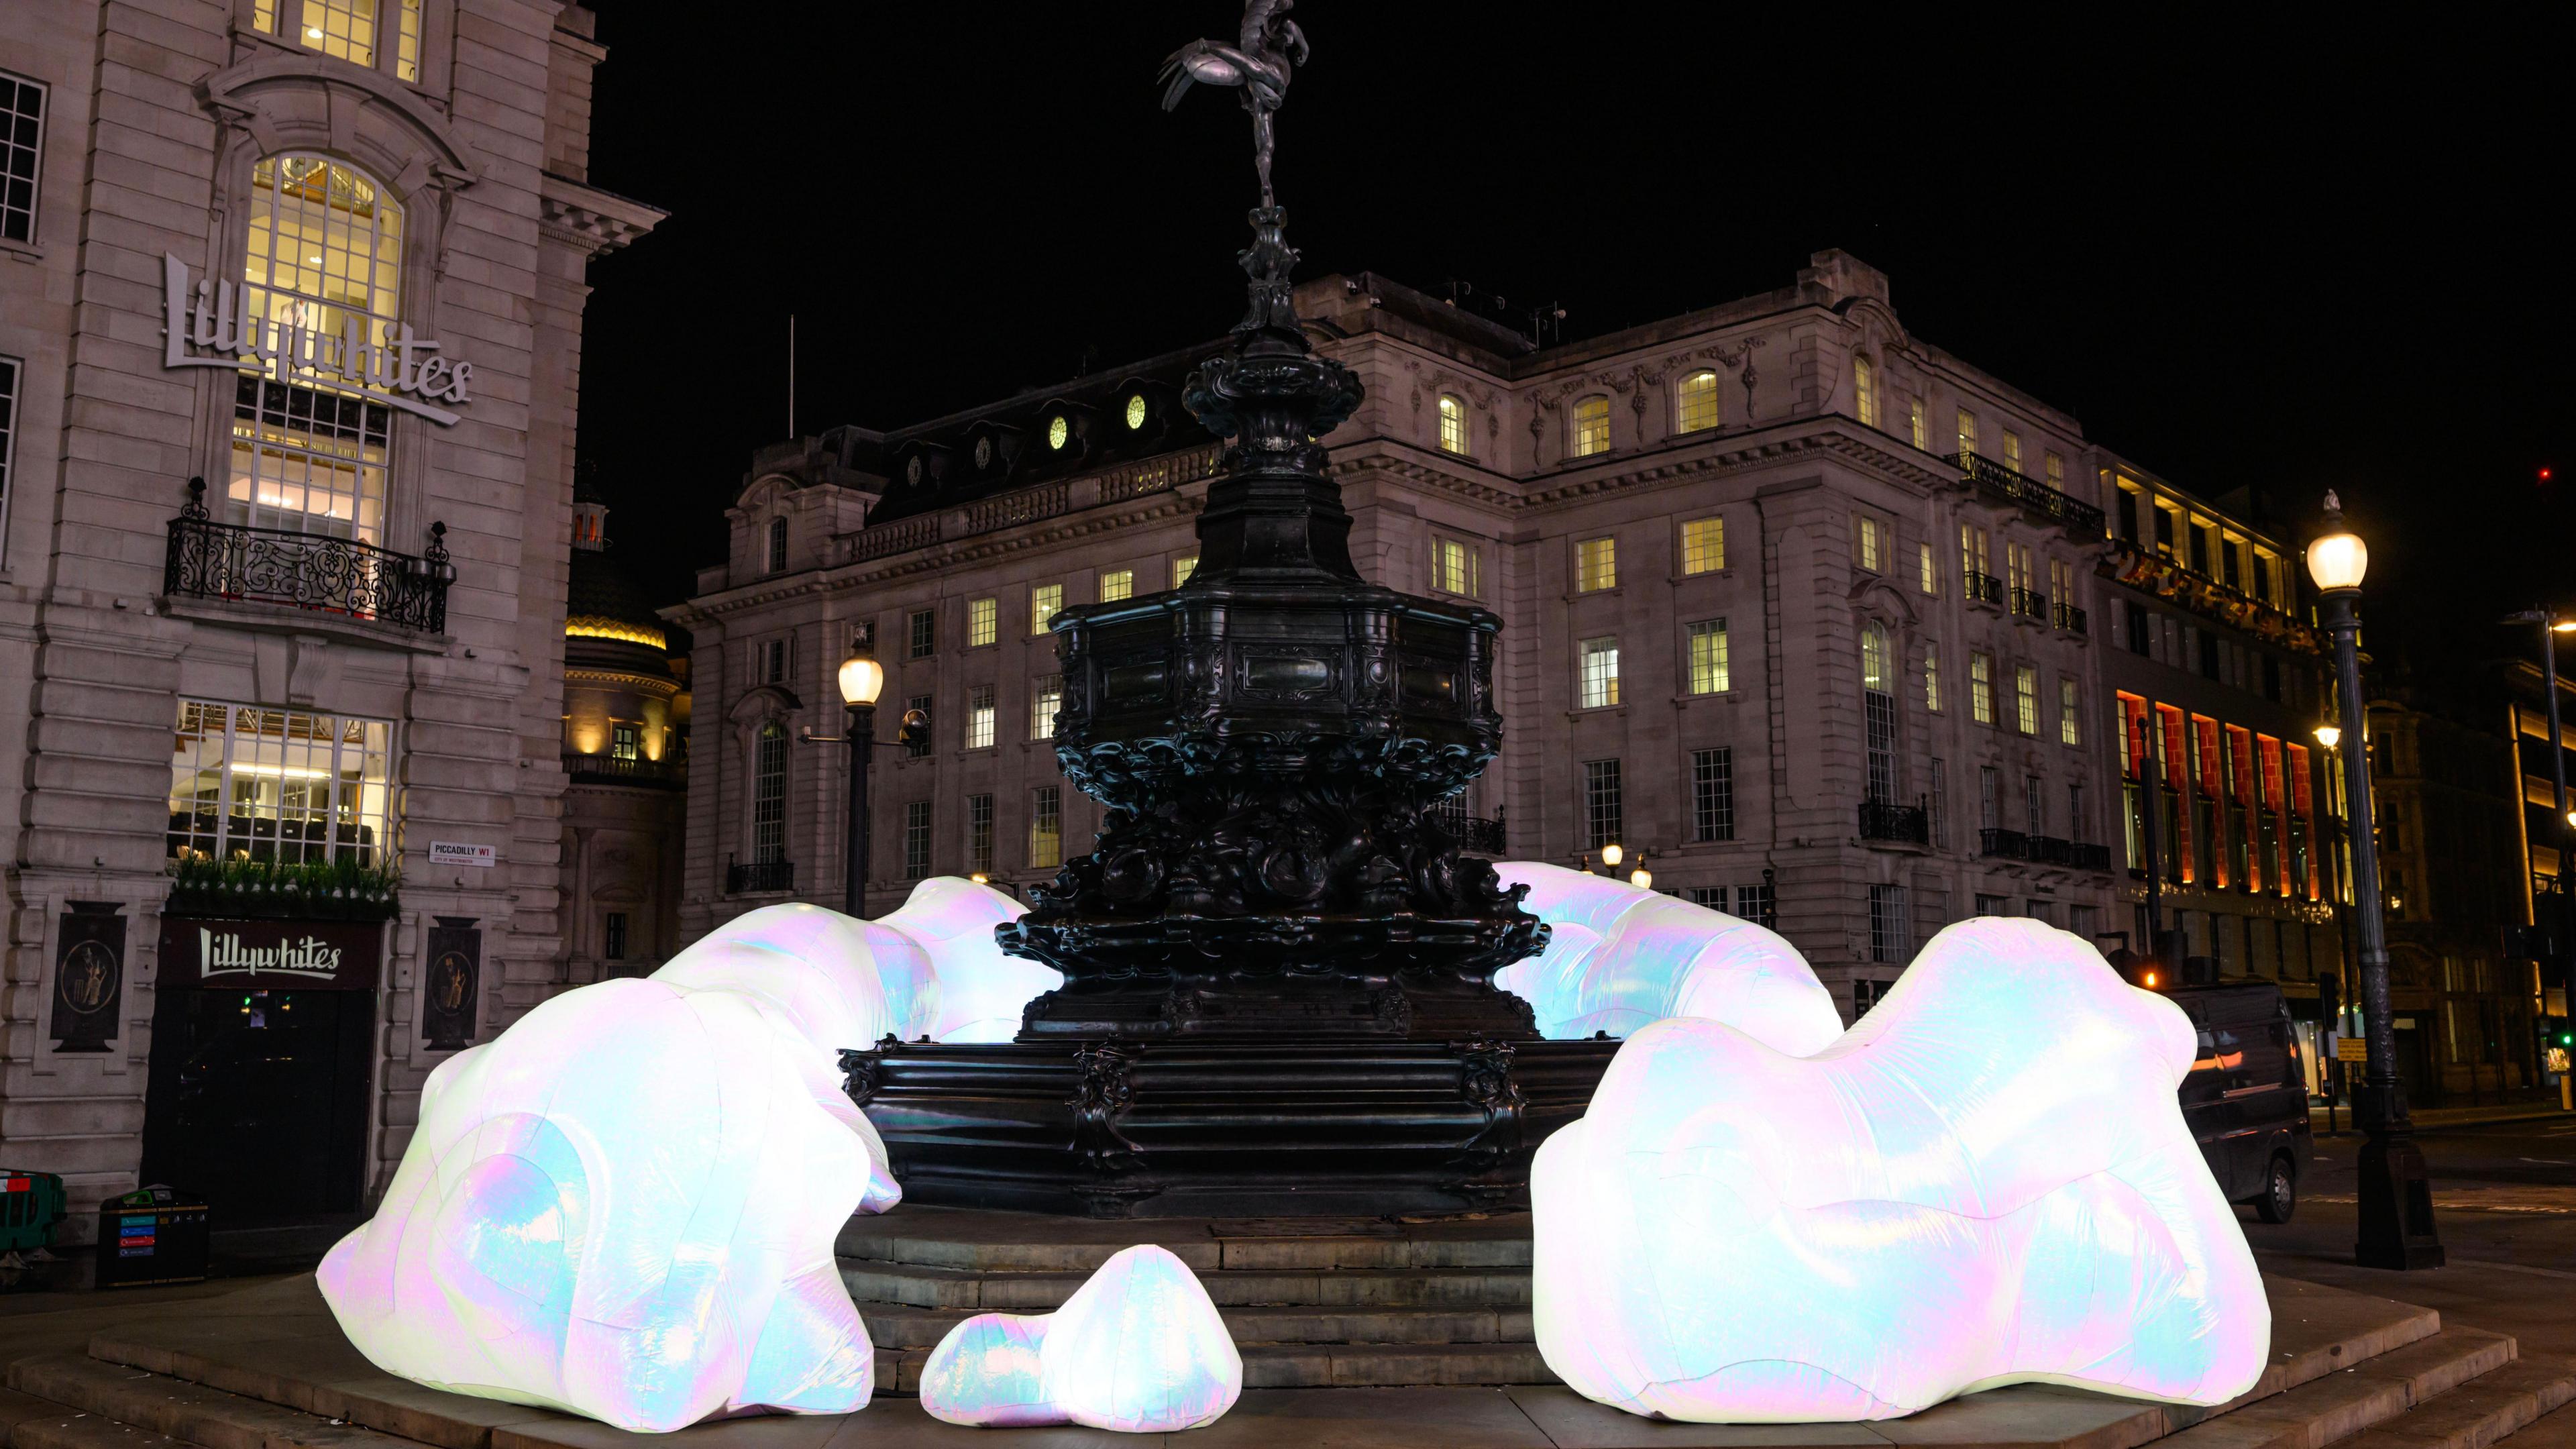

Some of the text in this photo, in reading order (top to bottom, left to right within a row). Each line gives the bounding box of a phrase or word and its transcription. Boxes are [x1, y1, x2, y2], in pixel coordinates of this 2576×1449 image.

[166, 251, 472, 425] Lillywhites
[435, 845, 489, 856] PICCADILLY W1
[201, 927, 341, 980] Lillywhites
